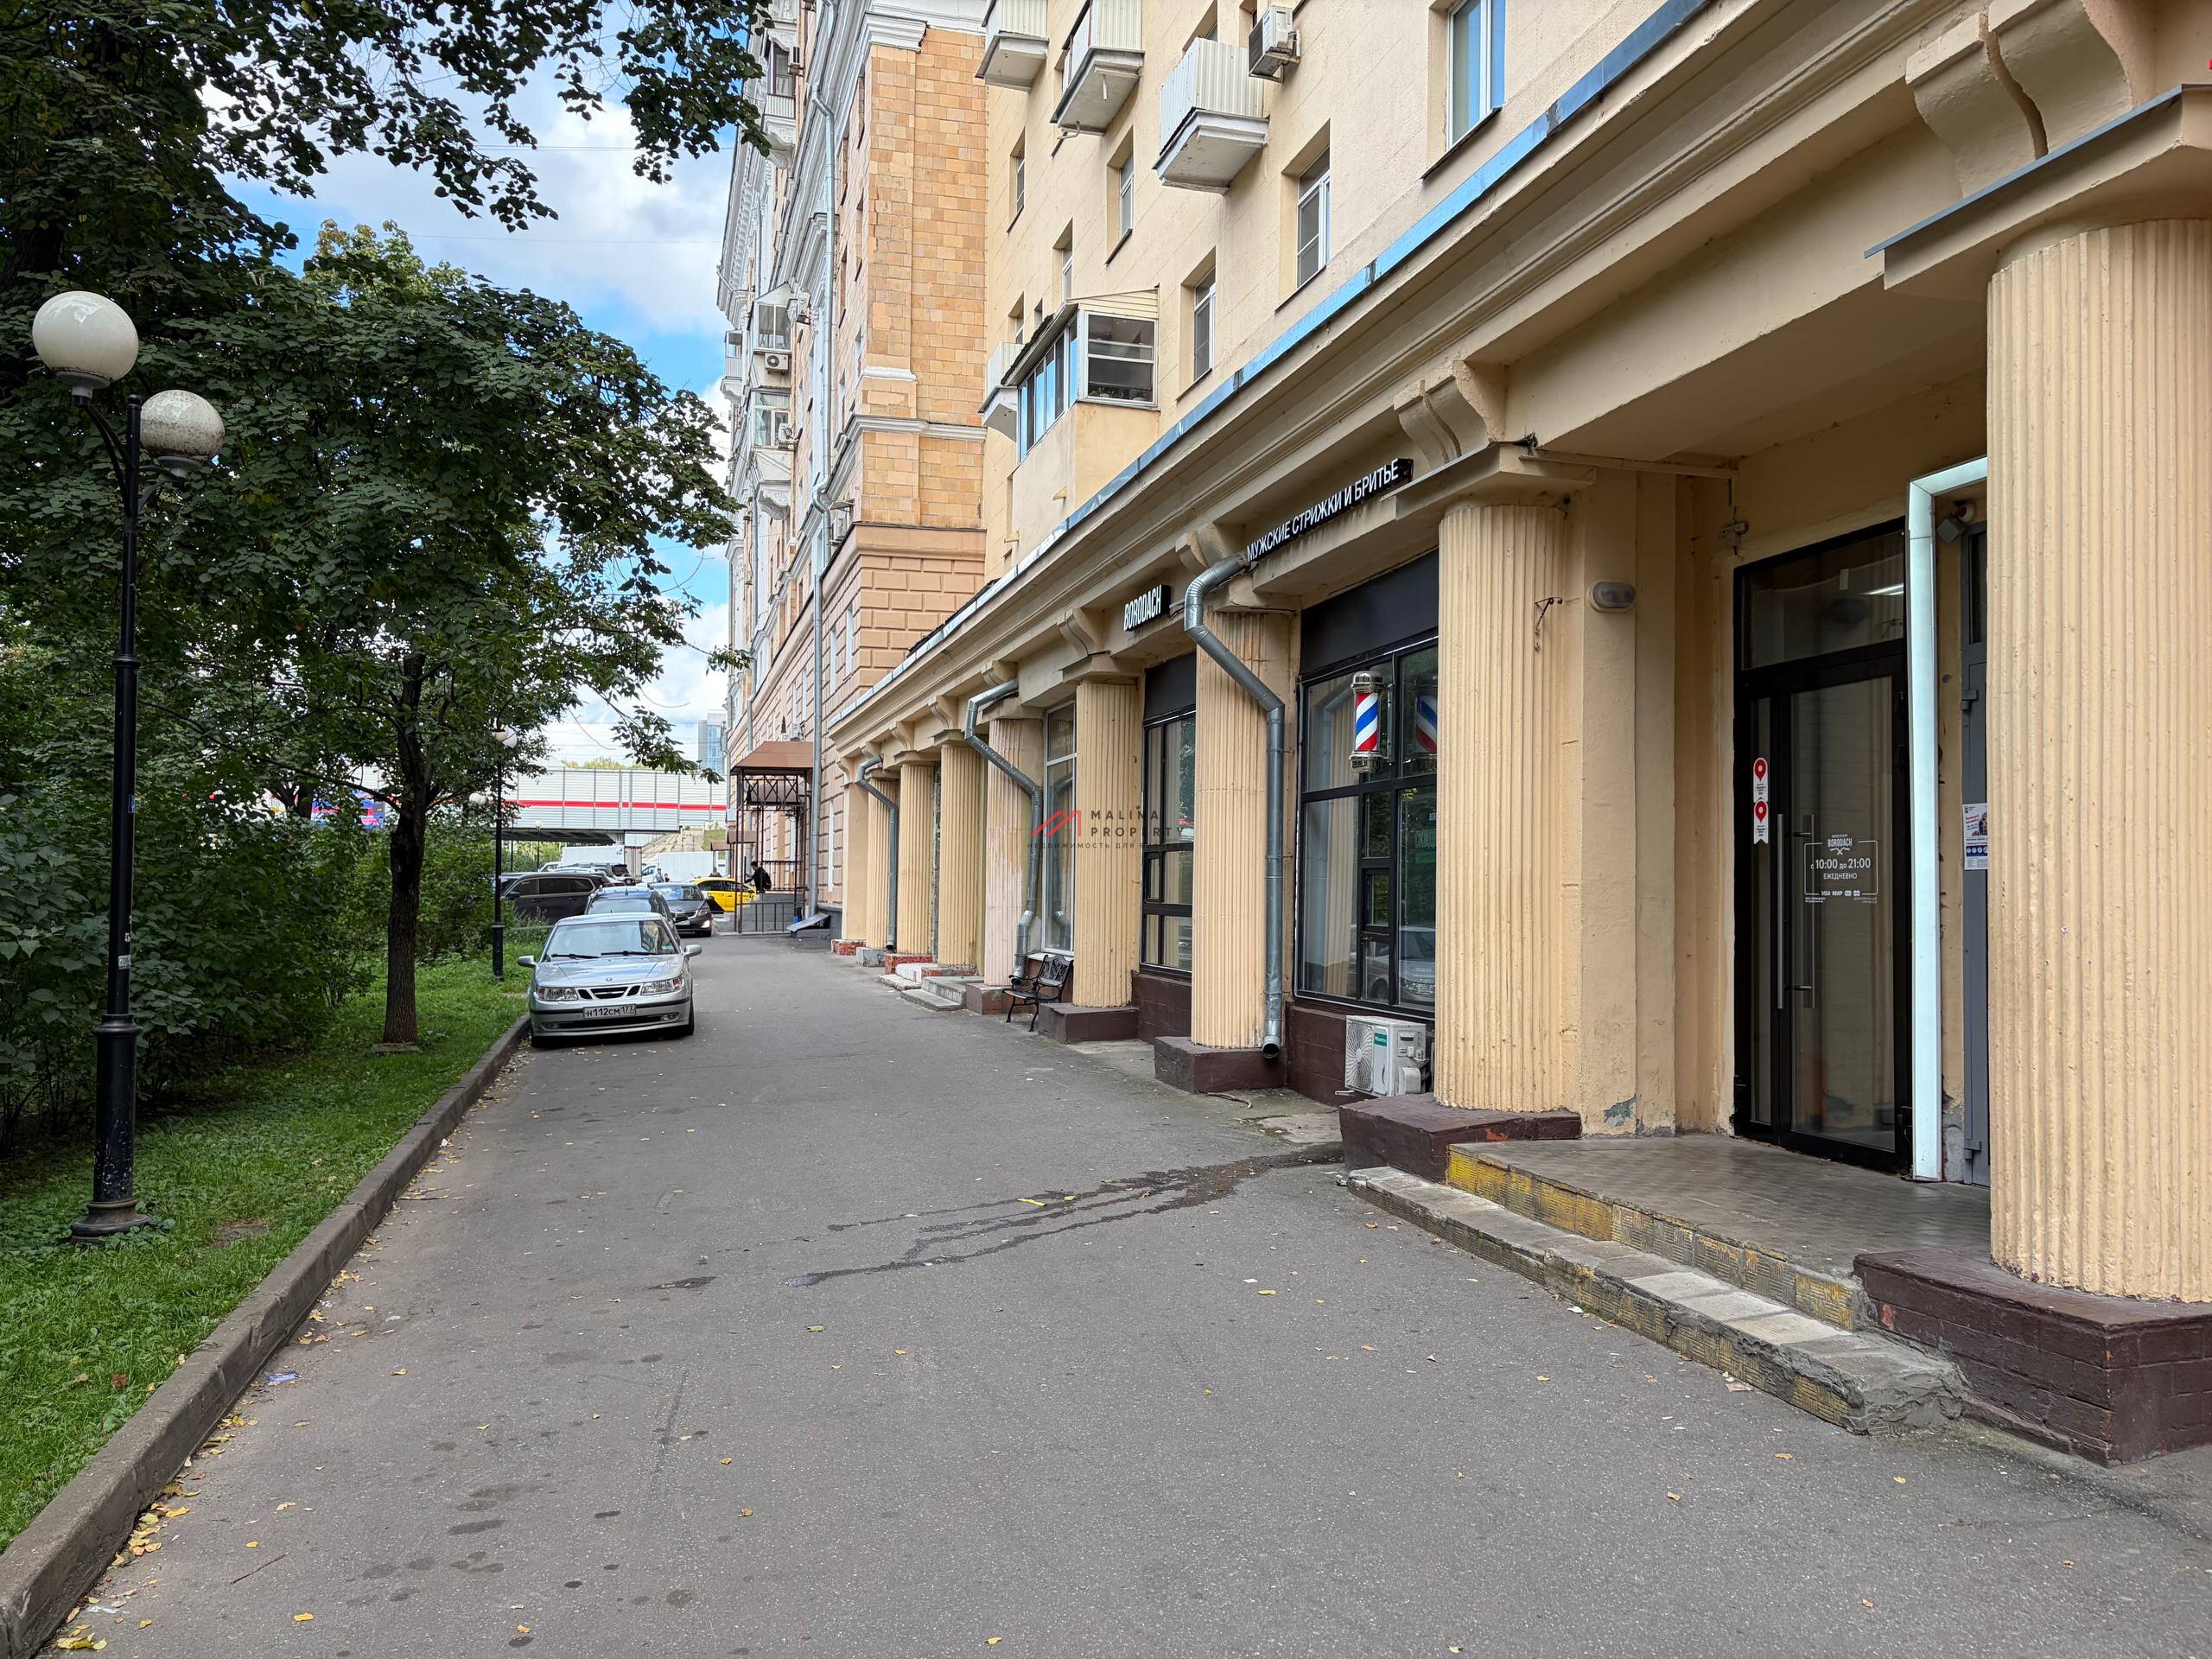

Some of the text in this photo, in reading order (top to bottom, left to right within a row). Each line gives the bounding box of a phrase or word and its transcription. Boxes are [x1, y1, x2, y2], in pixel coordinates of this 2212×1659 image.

[1246, 458, 1399, 562] МУЖСКИЕ СТРИЖКИ И БРИТЬЕ
[1123, 585, 1162, 632] BORODACH
[1815, 859, 1838, 869] 10:00
[1847, 858, 1871, 869] 21:00
